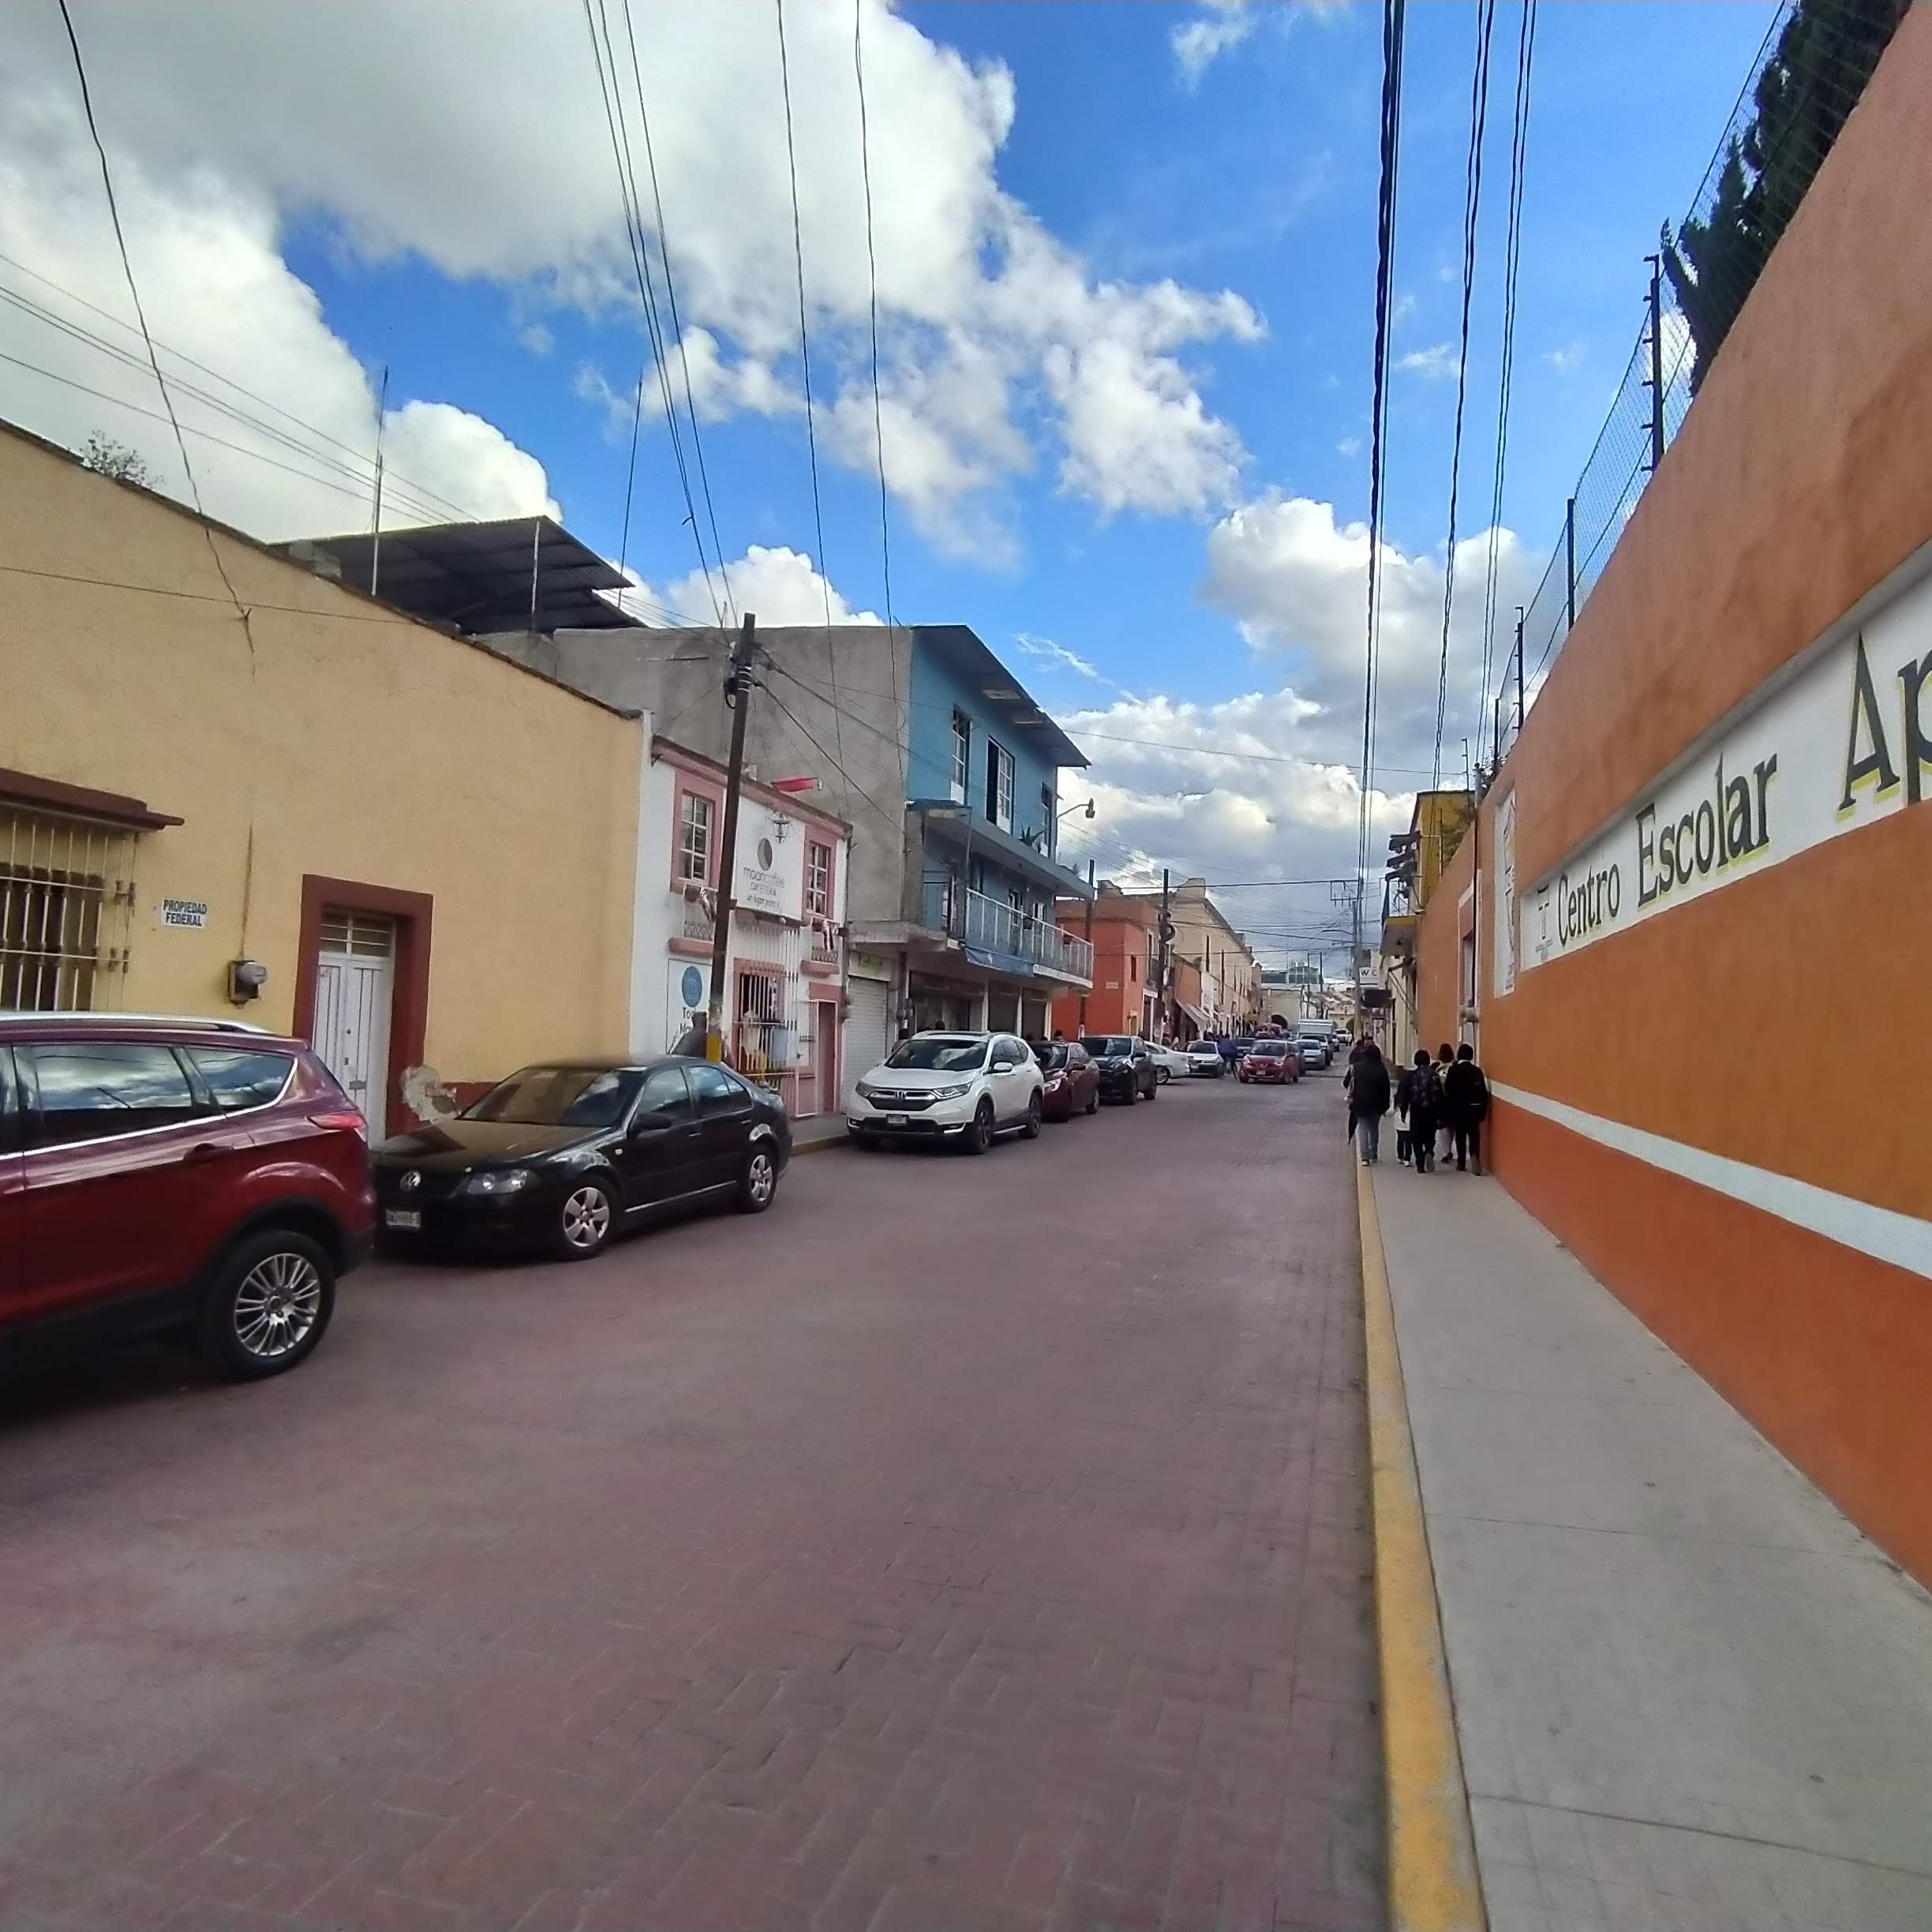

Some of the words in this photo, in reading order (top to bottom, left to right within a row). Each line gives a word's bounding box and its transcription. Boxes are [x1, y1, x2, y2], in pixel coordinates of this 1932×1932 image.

[1559, 863, 1620, 946] Centro
[1635, 751, 1777, 908] Escolar
[163, 899, 207, 915] PROPIEDAD
[165, 912, 202, 927] FEDERAL
